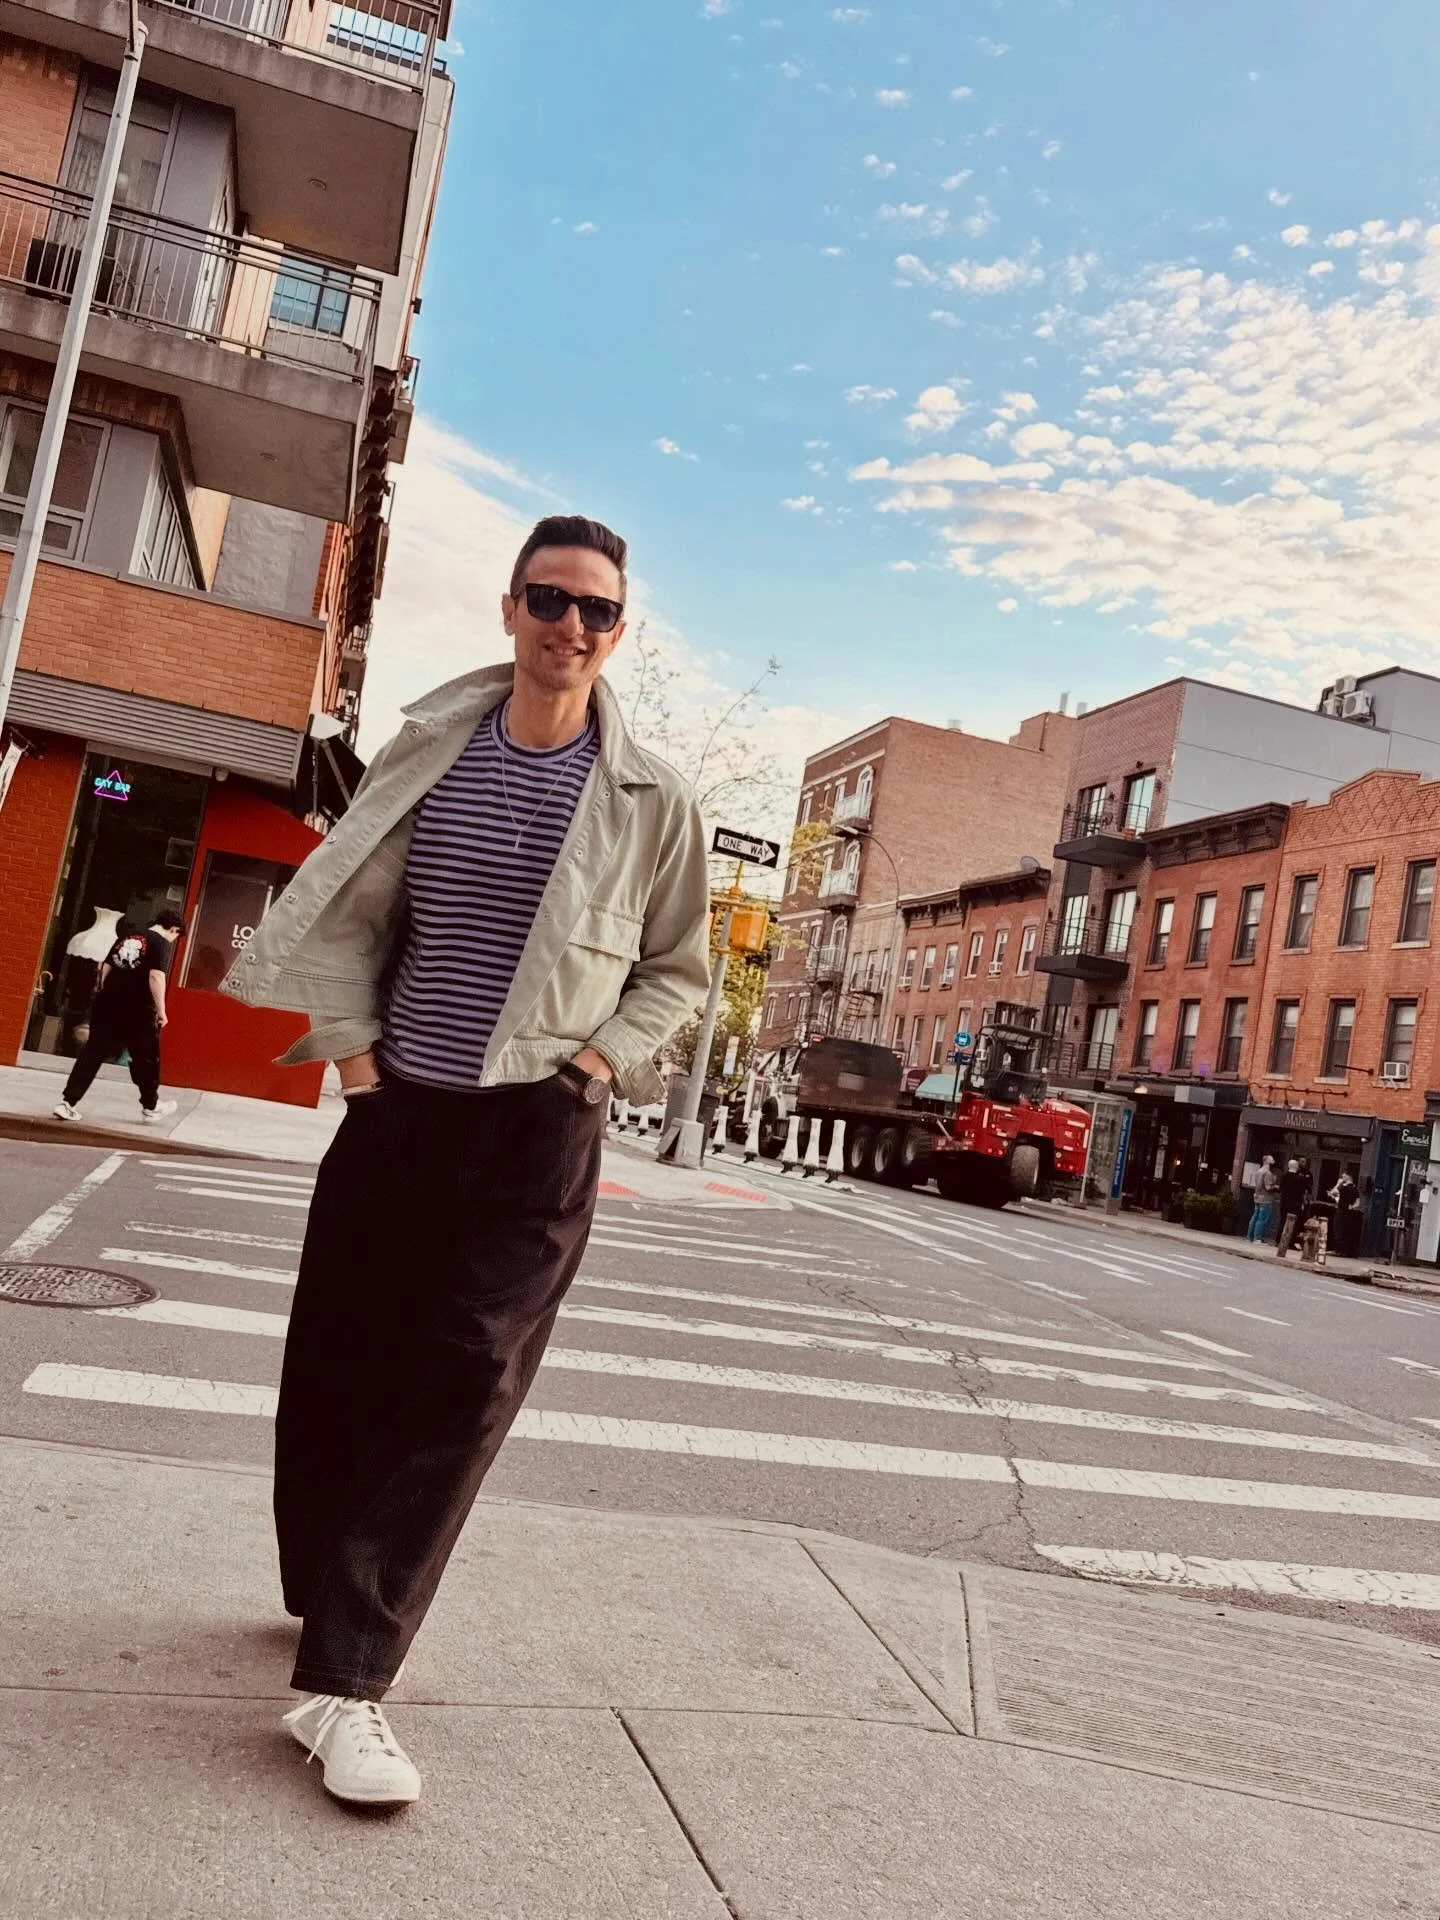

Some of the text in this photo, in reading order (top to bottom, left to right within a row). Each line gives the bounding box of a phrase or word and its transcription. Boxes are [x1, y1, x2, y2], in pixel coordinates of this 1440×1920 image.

[94, 777, 131, 793] GAY BAR
[722, 837, 770, 857] ONE WAY
